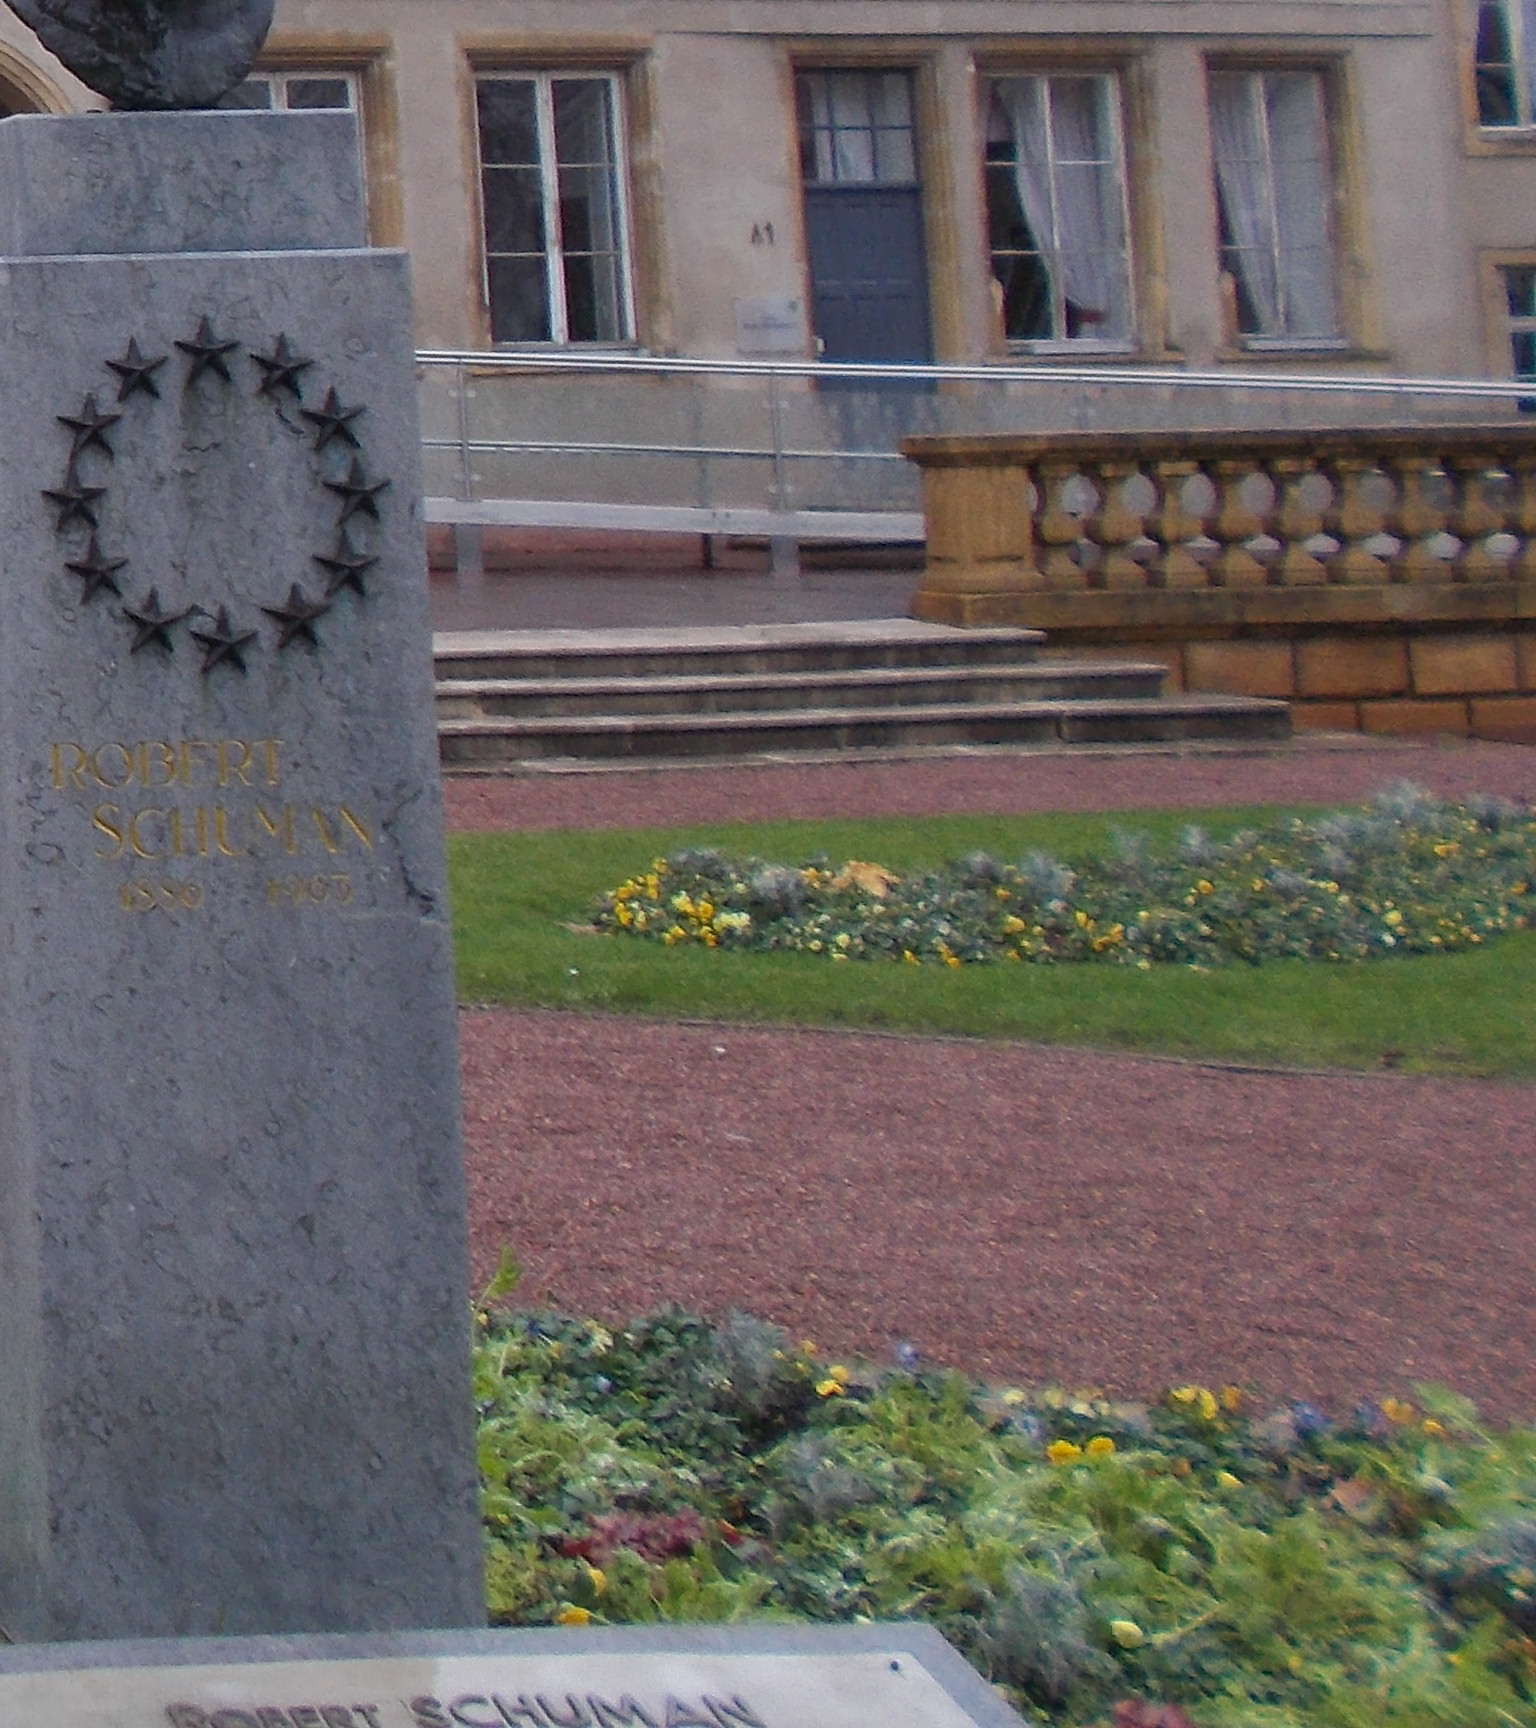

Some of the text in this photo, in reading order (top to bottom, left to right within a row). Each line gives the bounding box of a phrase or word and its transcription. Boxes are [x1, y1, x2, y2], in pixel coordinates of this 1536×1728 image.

[50, 740, 284, 789] ROBERT
[91, 803, 374, 859] SCHUMAN
[409, 1692, 766, 1728] SCHUMAN
